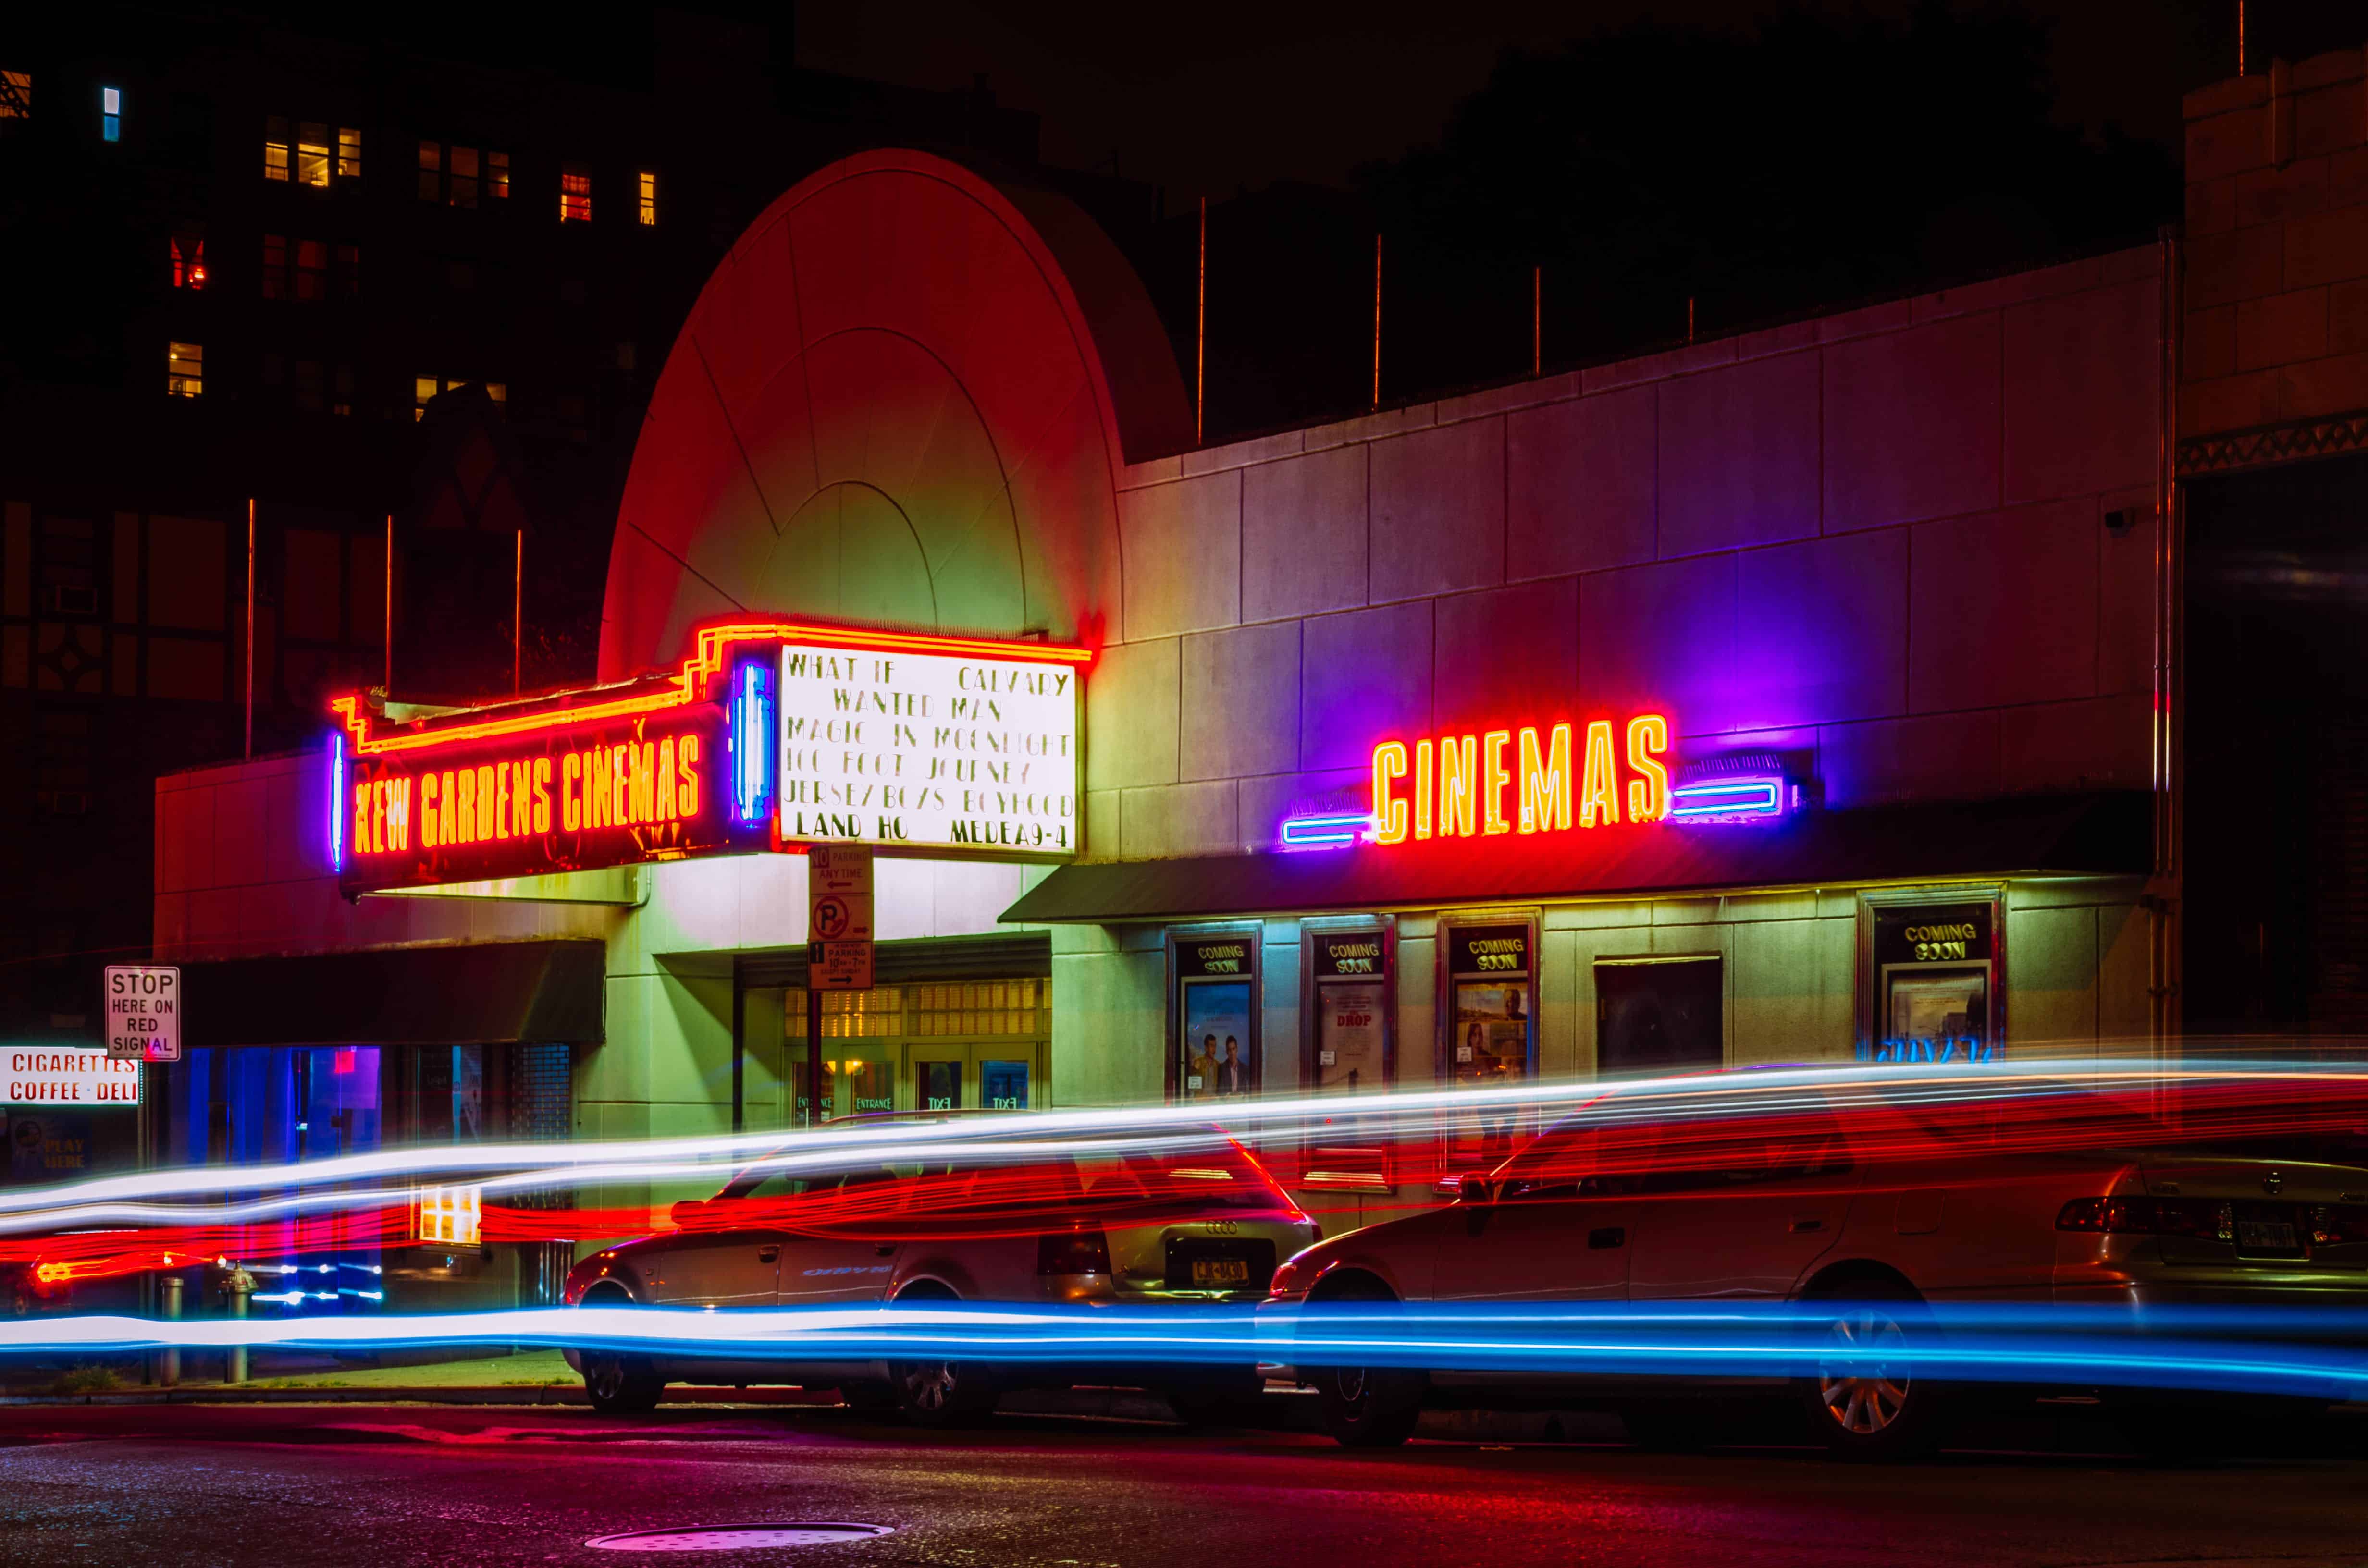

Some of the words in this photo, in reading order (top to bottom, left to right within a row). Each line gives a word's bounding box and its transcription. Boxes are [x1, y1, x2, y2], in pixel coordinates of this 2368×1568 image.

[788, 653, 857, 682] WHAT
[875, 660, 894, 683] IF
[959, 667, 1068, 696] CALVARY
[834, 688, 934, 717] WANTED
[952, 698, 1001, 722] MAN
[788, 716, 866, 745] MAGIC
[894, 723, 916, 747] IN
[934, 727, 1070, 757] MOONLIGHT
[843, 751, 904, 776] FOOT
[1372, 714, 1668, 845] CINEMAS
[355, 778, 410, 853] KEW
[421, 758, 550, 847] GARDENS
[563, 735, 699, 832] CINEMAS
[784, 780, 873, 806] JERSEY
[797, 812, 861, 837] LAND
[878, 815, 908, 839] HO
[833, 852, 867, 861] PARKING
[1905, 924, 1976, 942] COMING
[829, 949, 865, 957] PARKING
[1199, 945, 1244, 959] COMING
[1330, 944, 1379, 958] COMING
[1469, 939, 1524, 954] COMING
[1915, 942, 1965, 960] SOON
[1205, 959, 1238, 972] SOON
[1336, 959, 1372, 973] SOON
[1477, 954, 1517, 970] SOON
[112, 974, 173, 994] STOP
[112, 999, 147, 1013] HERE
[155, 999, 173, 1013] ON
[128, 1018, 158, 1032] RED
[1337, 1014, 1372, 1027] DROP
[114, 1037, 173, 1052] SIGNAL
[12, 1054, 135, 1073] CIGARETTES
[10, 1081, 80, 1100] COFFEE
[97, 1081, 137, 1100] DELI
[857, 1098, 891, 1110] ENTRANCE
[46, 1139, 85, 1153] PLAY
